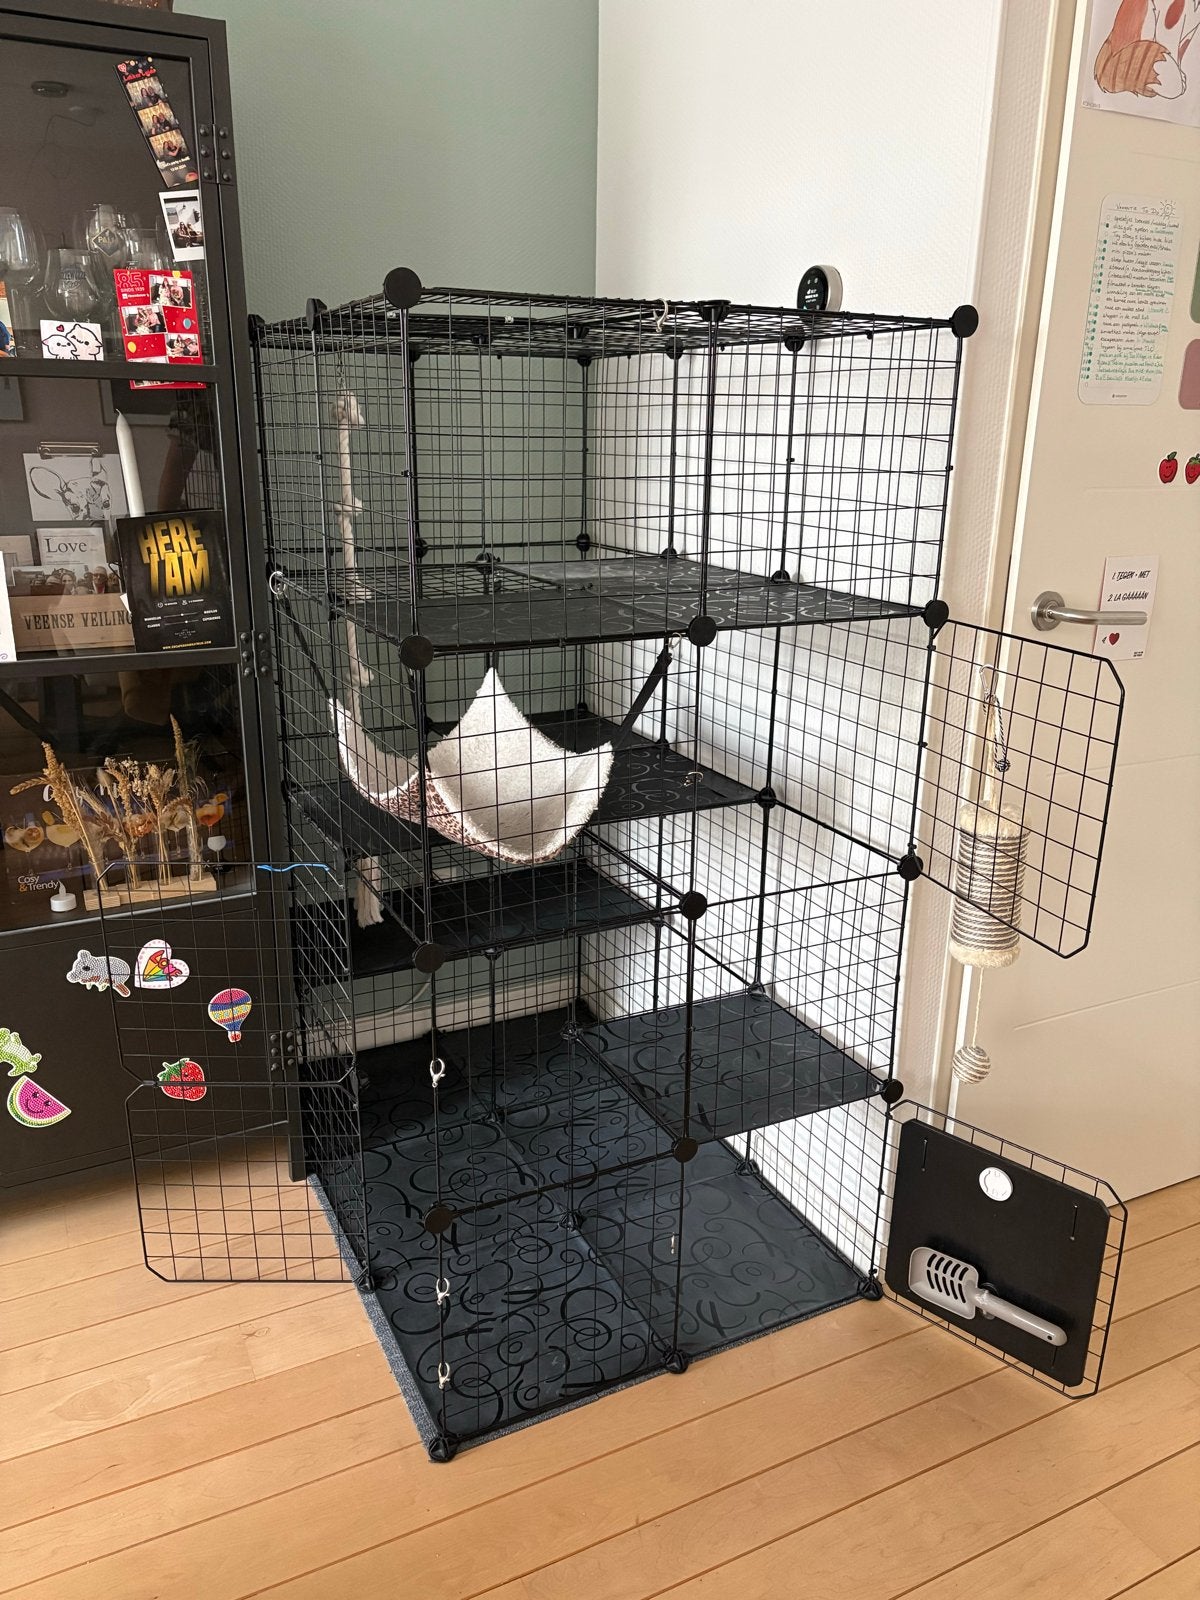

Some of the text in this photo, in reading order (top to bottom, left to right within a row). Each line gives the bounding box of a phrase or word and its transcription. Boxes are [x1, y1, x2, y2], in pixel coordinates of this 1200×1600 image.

[118, 272, 145, 288] 85
[44, 538, 87, 553] Love
[136, 518, 204, 564] HERE
[165, 549, 210, 598] AM
[1137, 570, 1151, 579] MET
[1113, 593, 1122, 602] LA
[24, 613, 75, 630] VEENSE
[18, 875, 40, 884] Cosy
